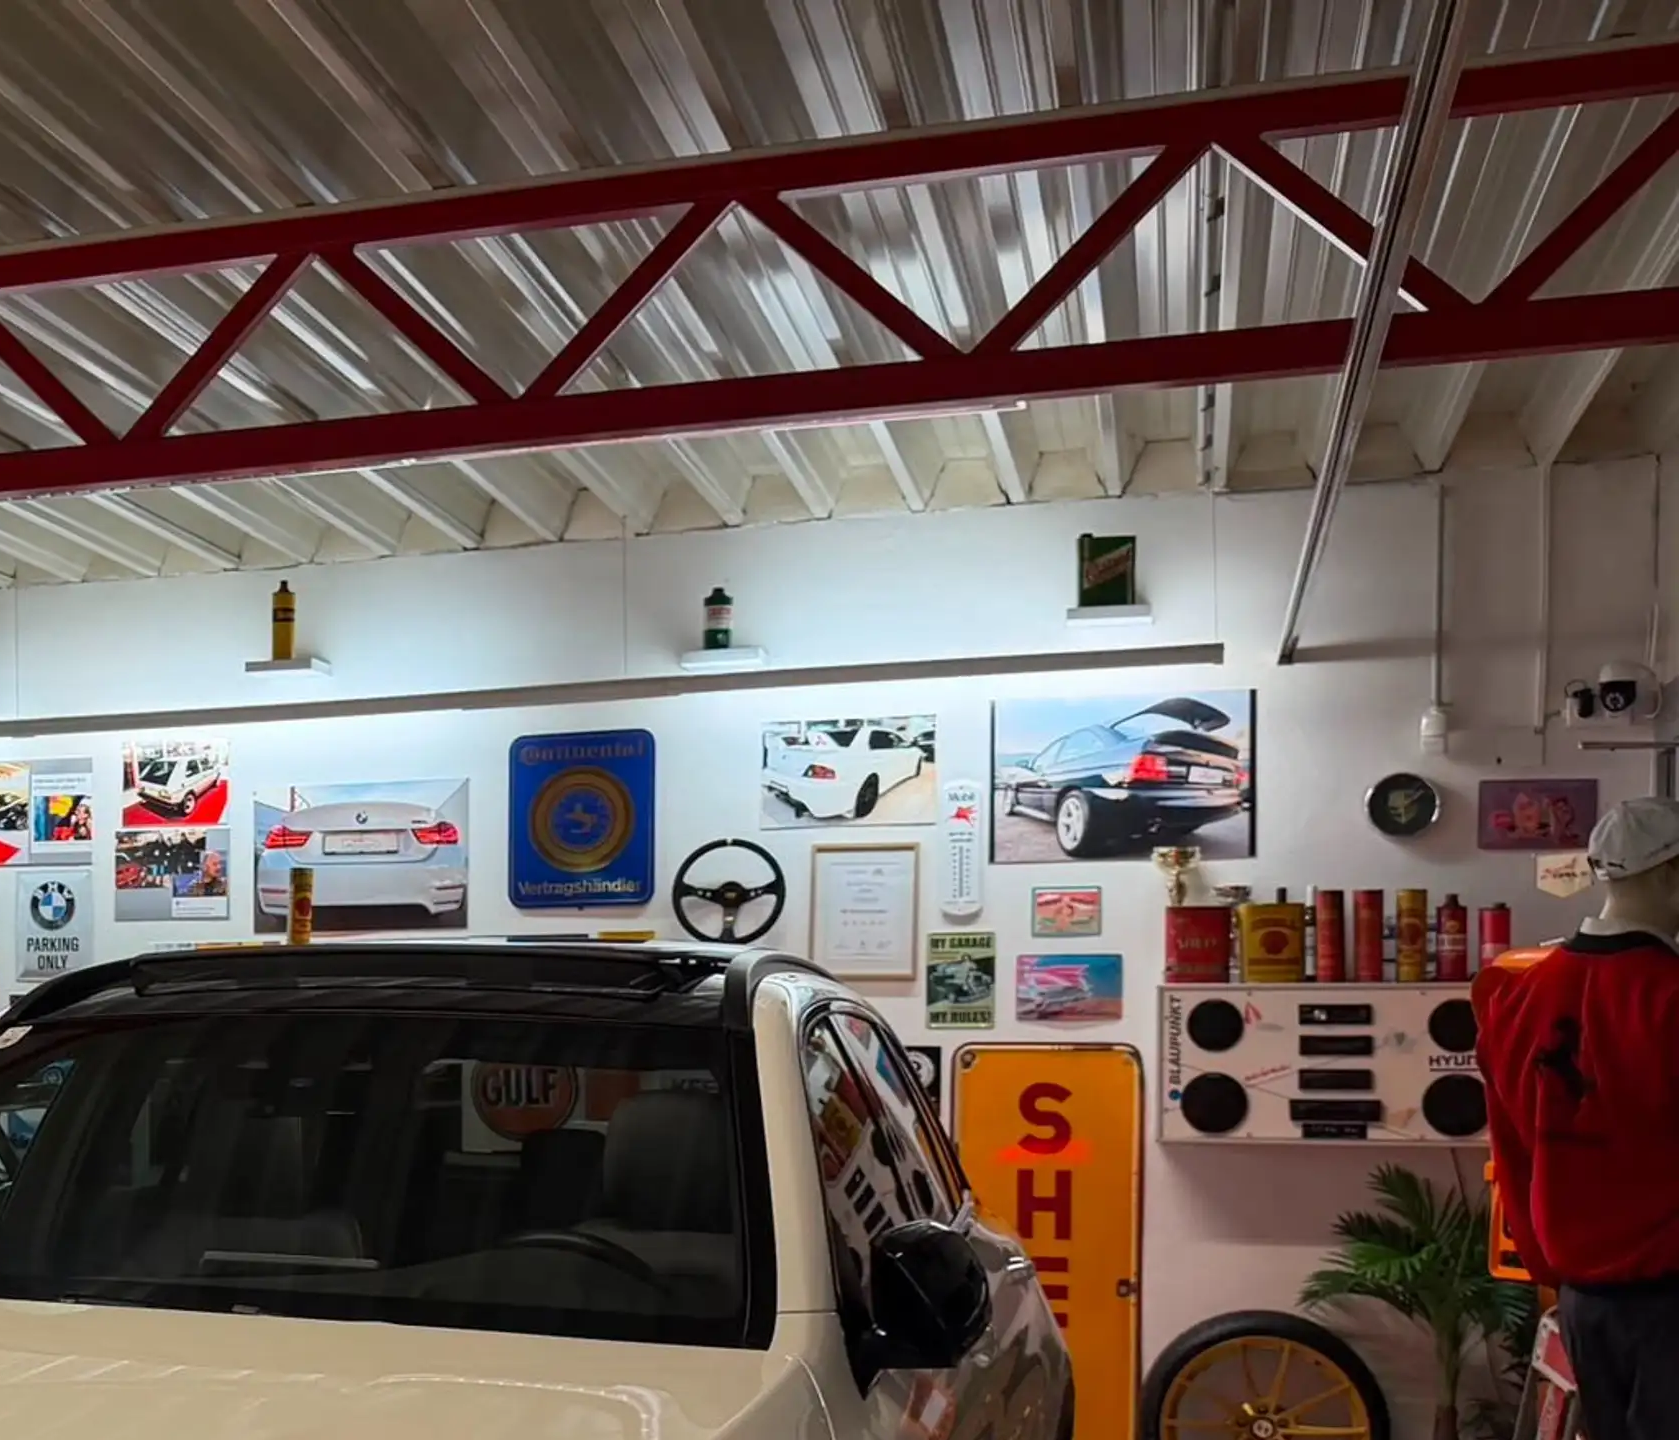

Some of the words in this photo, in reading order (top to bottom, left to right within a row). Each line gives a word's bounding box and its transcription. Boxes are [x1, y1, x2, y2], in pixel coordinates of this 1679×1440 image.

[520, 740, 645, 766] Continental
[518, 877, 641, 897] Vertragshändler
[26, 936, 80, 952] PARKING
[930, 937, 947, 949] MY
[948, 935, 993, 950] GARAGE
[37, 954, 69, 970] ONLY
[930, 1011, 948, 1023] MY
[949, 1010, 993, 1024] RULES!
[1169, 994, 1182, 1086] BLAUPUNKT
[481, 1067, 558, 1107] GULF
[1017, 1082, 1072, 1329] SHE
